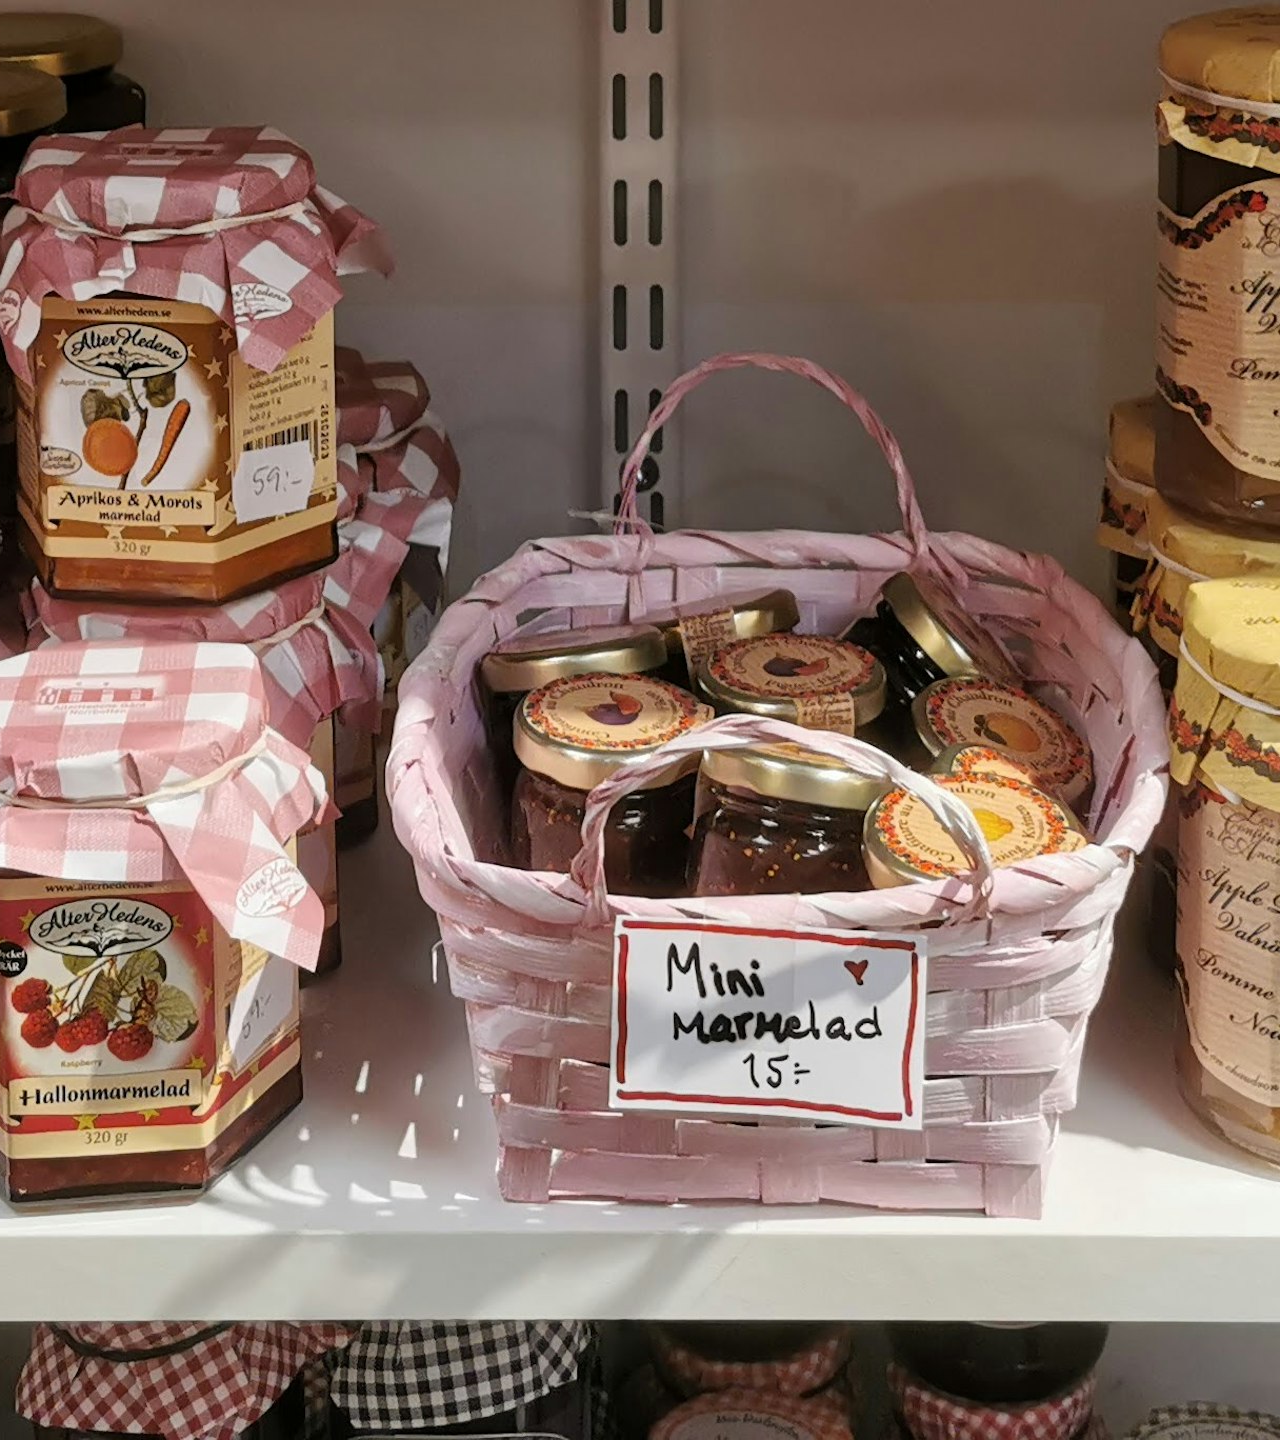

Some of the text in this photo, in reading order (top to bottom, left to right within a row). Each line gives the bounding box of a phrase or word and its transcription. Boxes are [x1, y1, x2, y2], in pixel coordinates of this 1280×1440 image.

[59, 491, 203, 509] Aprikos & Morots
[99, 510, 161, 523] marmelad
[1199, 866, 1264, 908] Äpple
[667, 942, 765, 998] Mini
[1195, 947, 1275, 1001] Pomme
[19, 1079, 191, 1106] Hallonmarmelad
[84, 1131, 129, 1146] 320 gr
